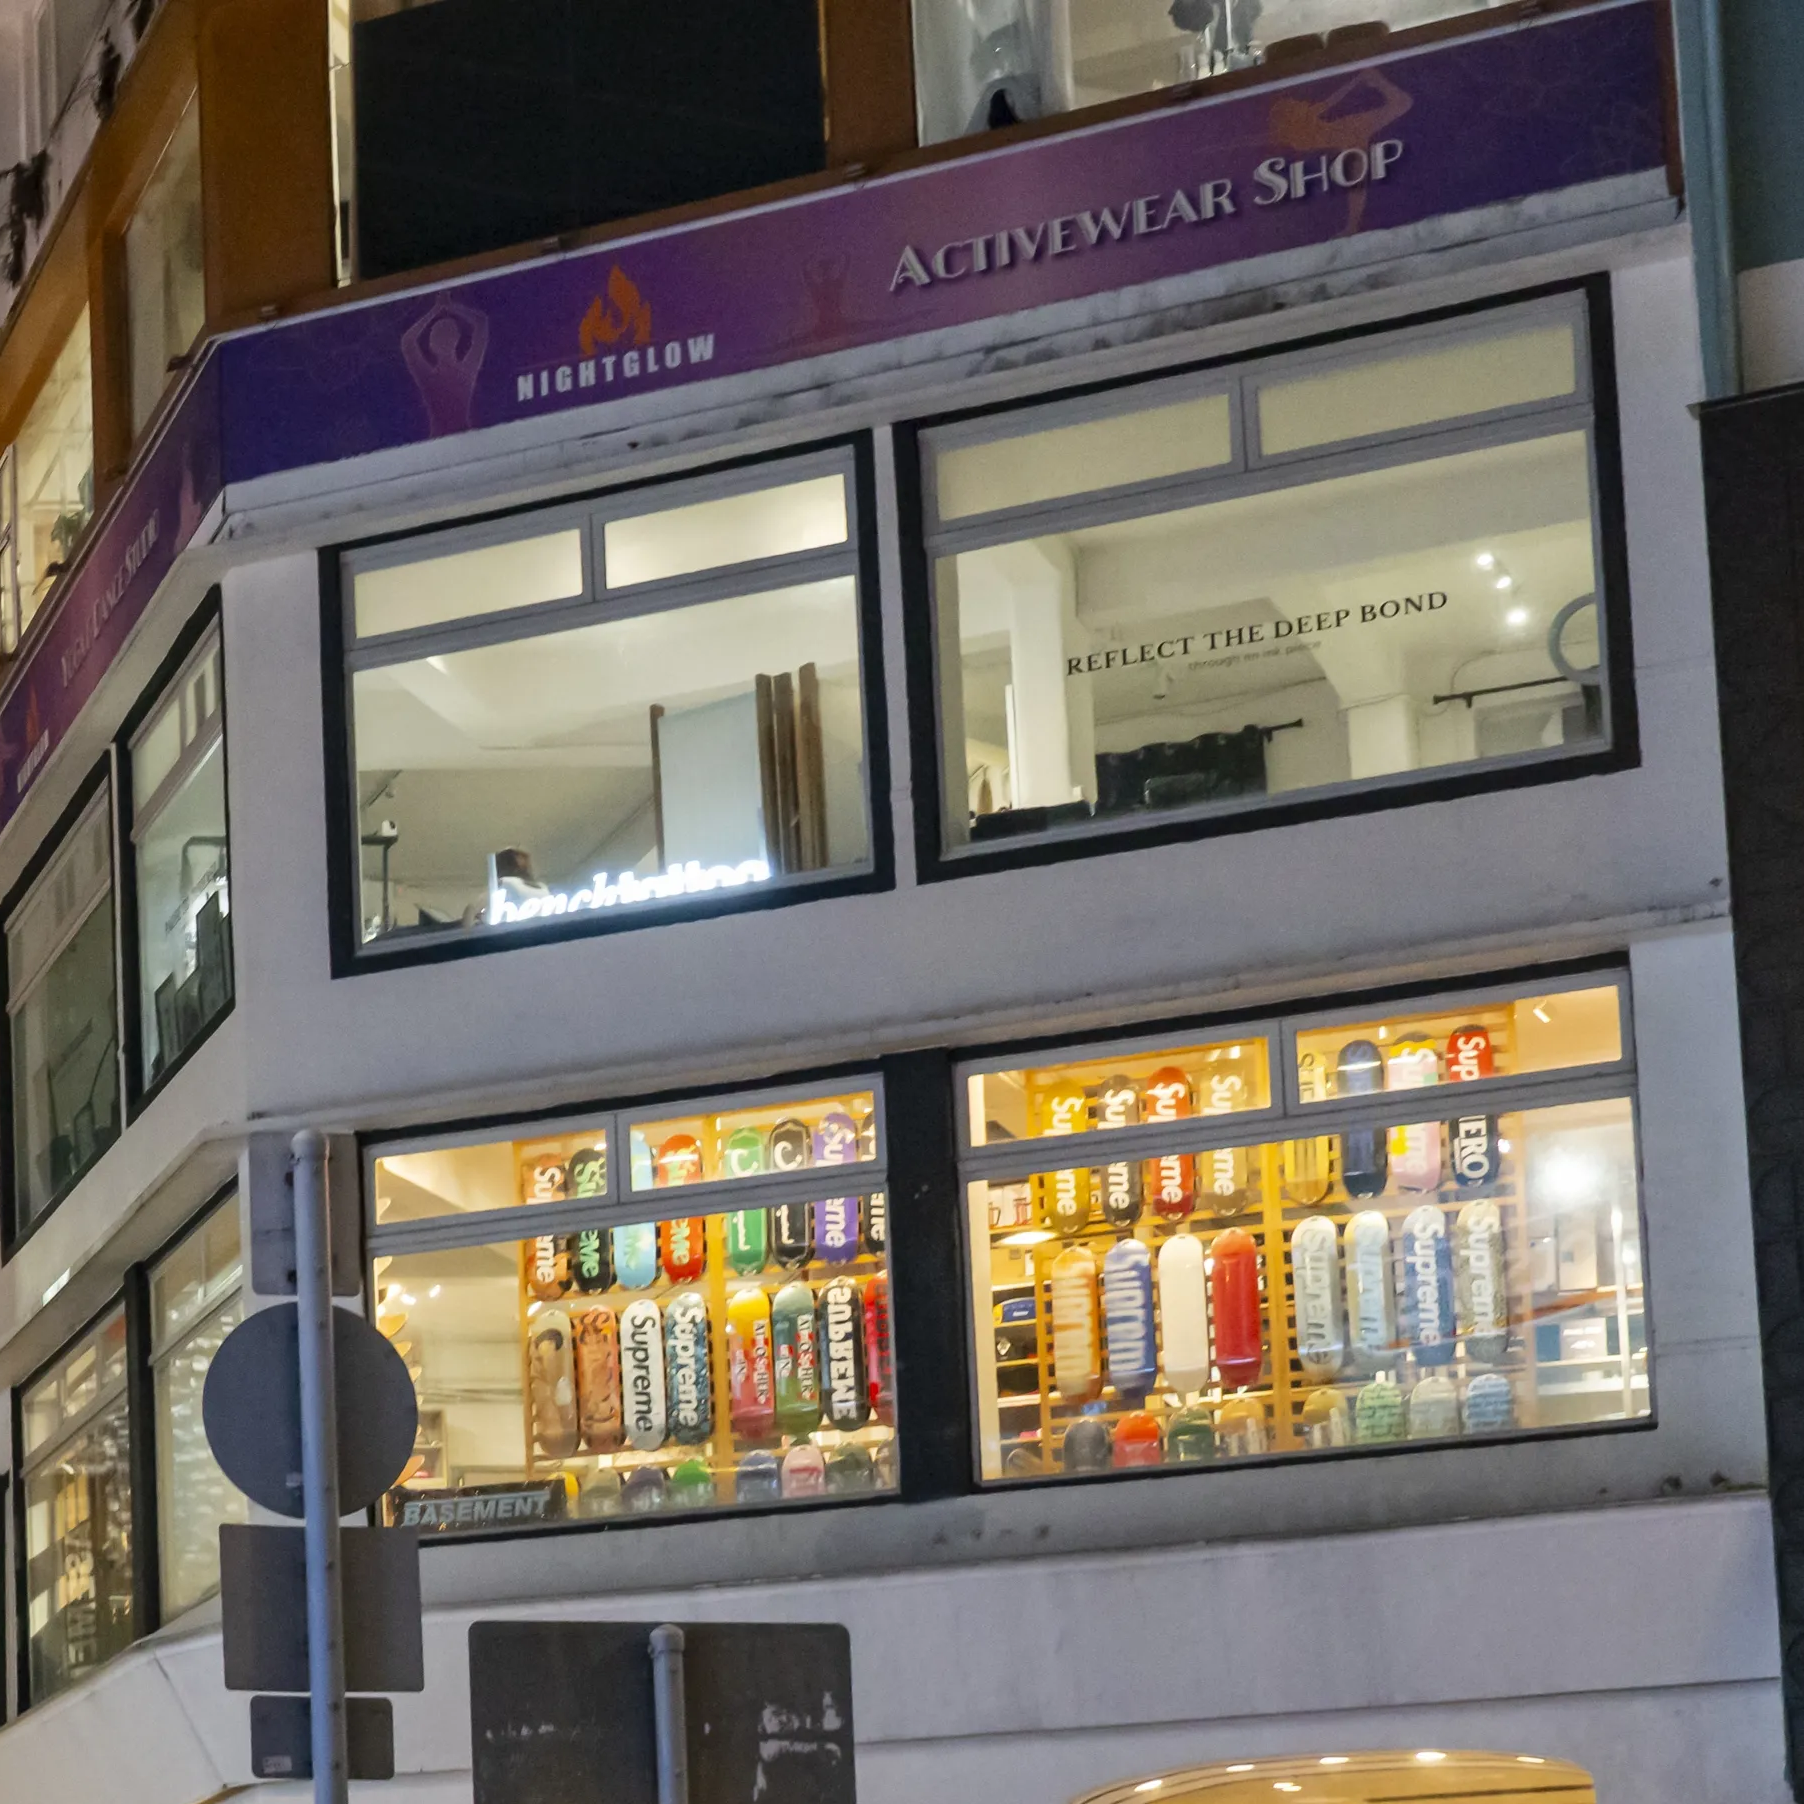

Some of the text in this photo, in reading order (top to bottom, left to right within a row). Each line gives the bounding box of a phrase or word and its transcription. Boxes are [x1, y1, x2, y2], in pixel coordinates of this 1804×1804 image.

[888, 140, 1404, 293] ACTIVEWEAR SHOP
[516, 333, 716, 402] NIGHTGLOW
[1066, 590, 1449, 676] REFLECT THE DEEP BOND
[1406, 1219, 1444, 1346] Supreme
[630, 1315, 657, 1433] Supreme
[672, 1302, 699, 1428] Supreme
[402, 1492, 554, 1527] BASEMENT
